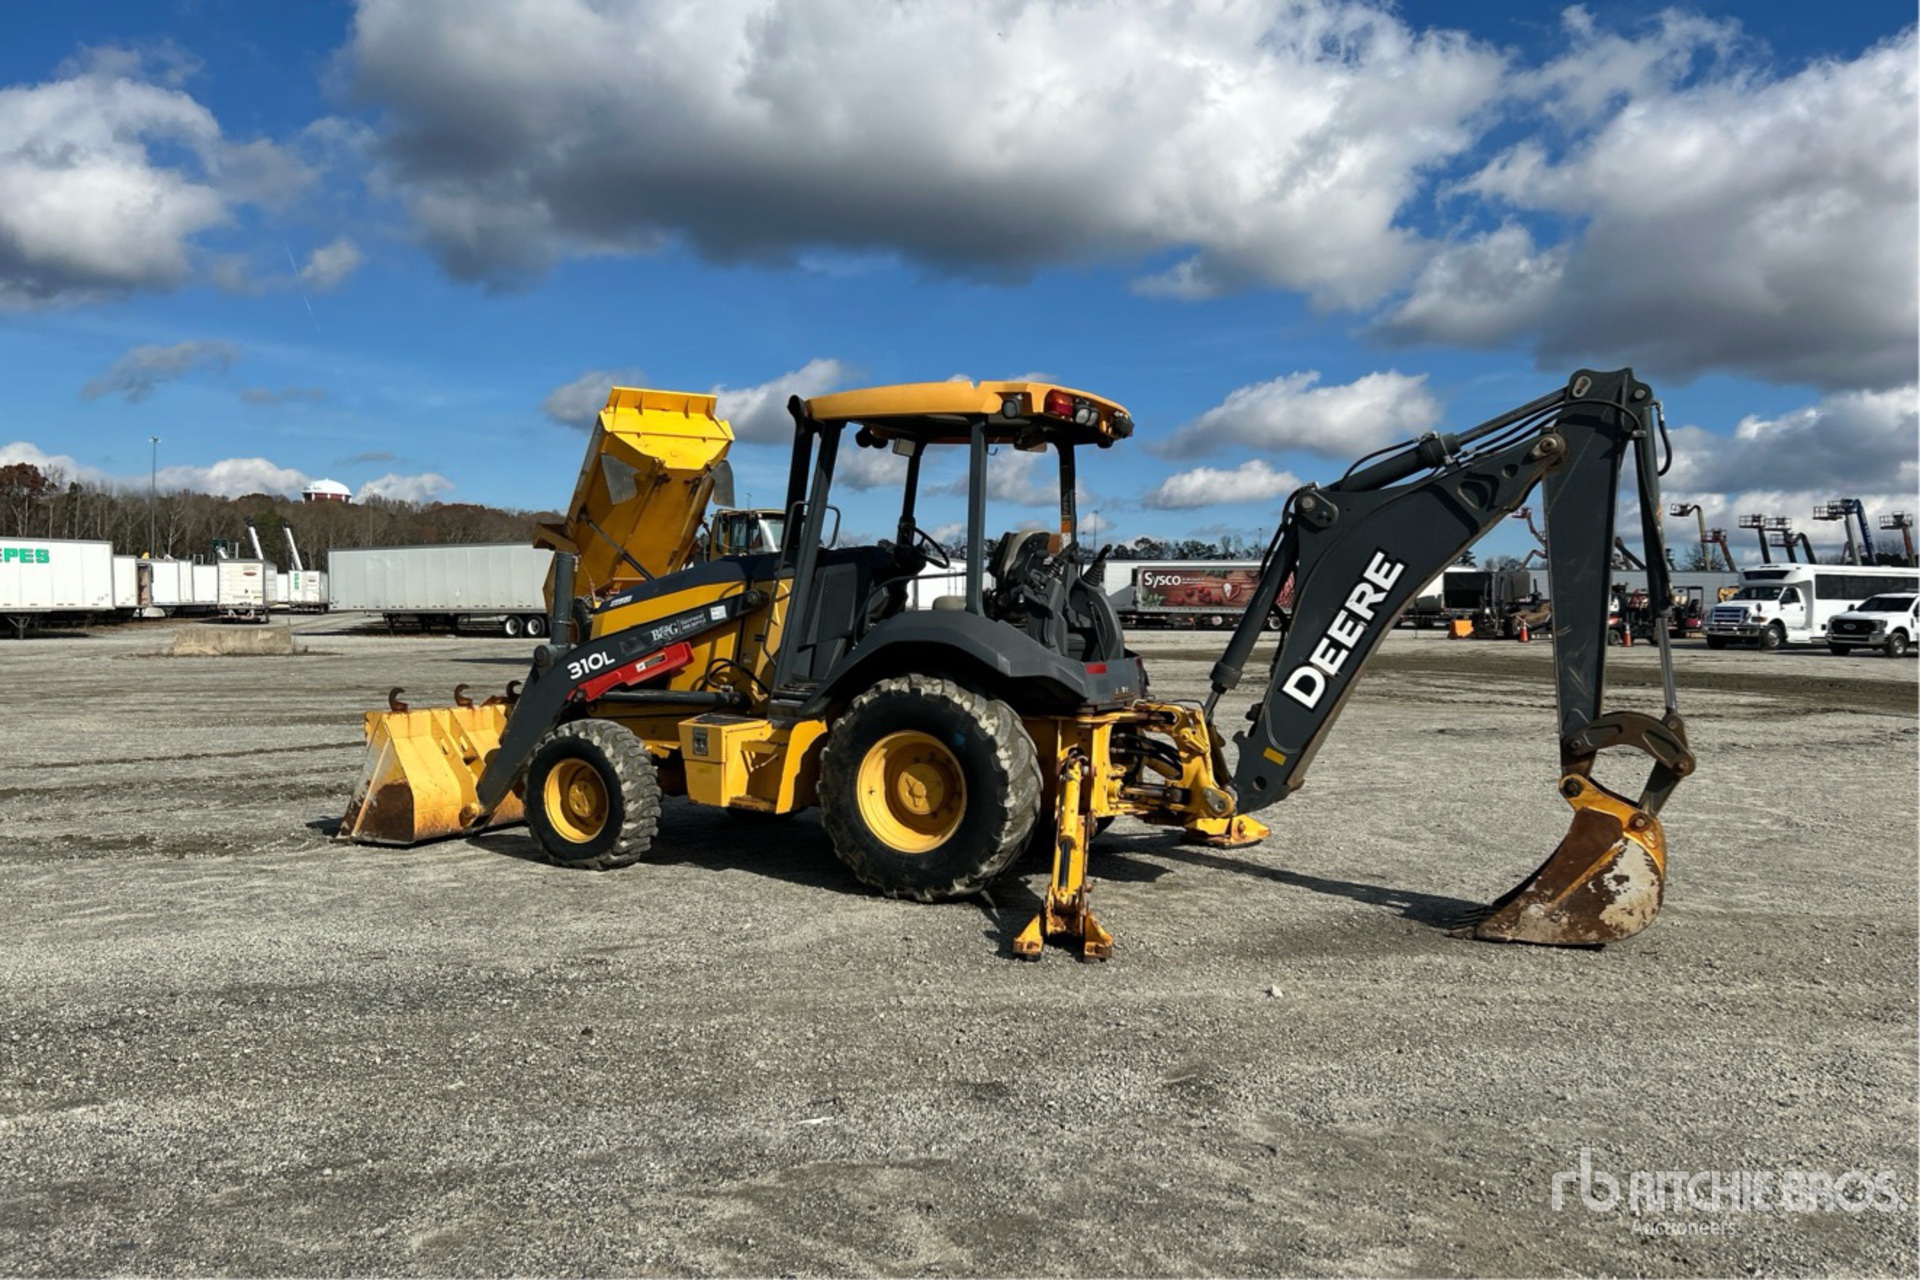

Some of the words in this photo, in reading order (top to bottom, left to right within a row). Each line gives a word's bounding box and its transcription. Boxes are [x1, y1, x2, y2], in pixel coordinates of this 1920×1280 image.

[0, 548, 50, 563] PES
[1144, 572, 1181, 588] Sysco
[1282, 551, 1405, 709] DEERE
[567, 651, 615, 680] 310L
